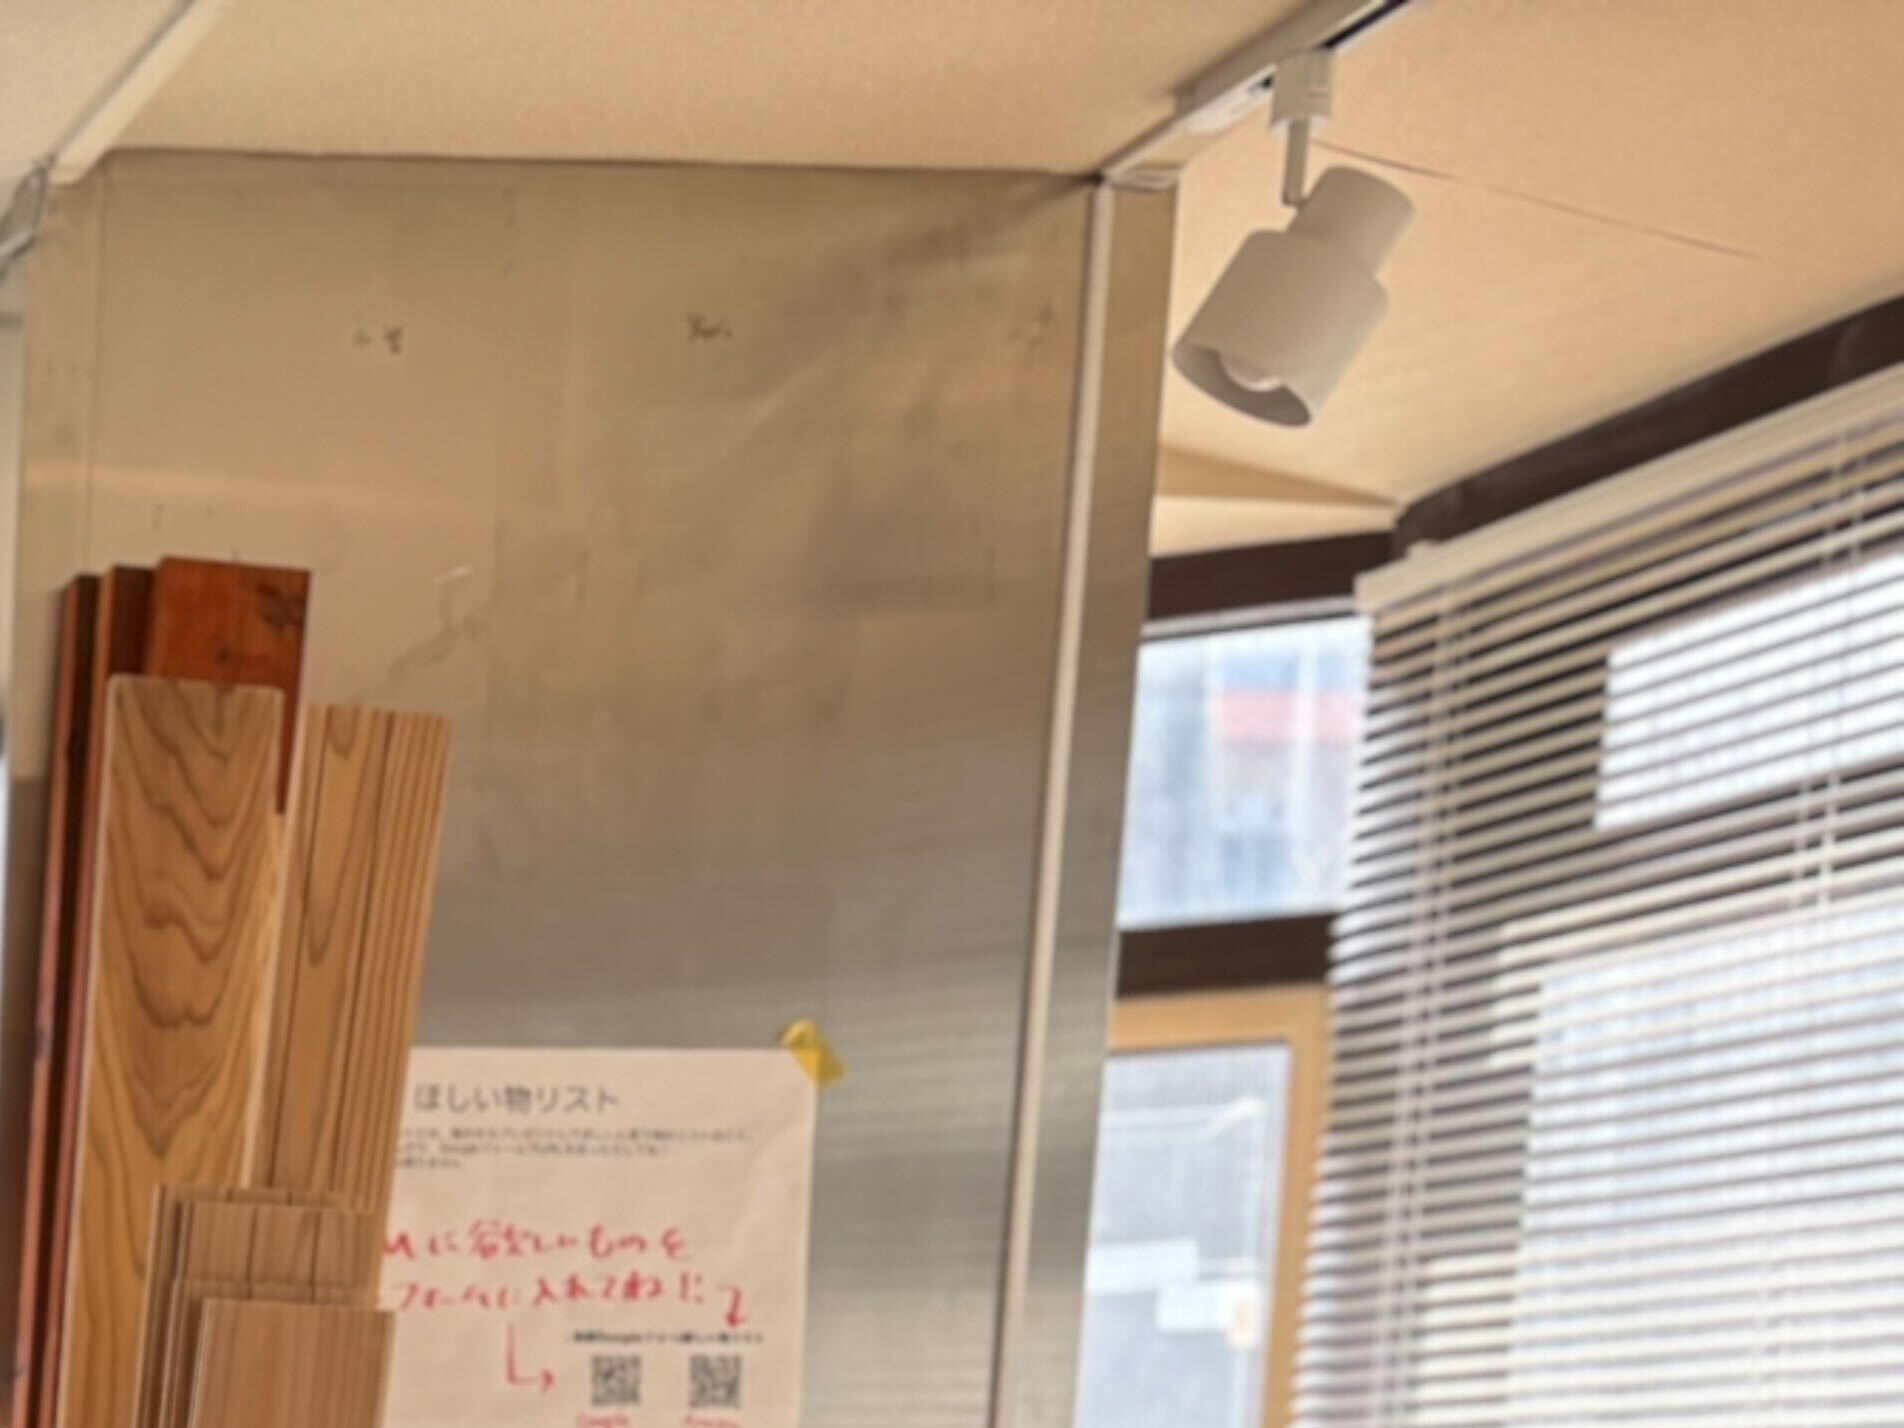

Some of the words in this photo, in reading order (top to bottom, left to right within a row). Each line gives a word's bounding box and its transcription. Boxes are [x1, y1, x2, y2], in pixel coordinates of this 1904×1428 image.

[413, 1083, 619, 1115] ほしい物リスト
